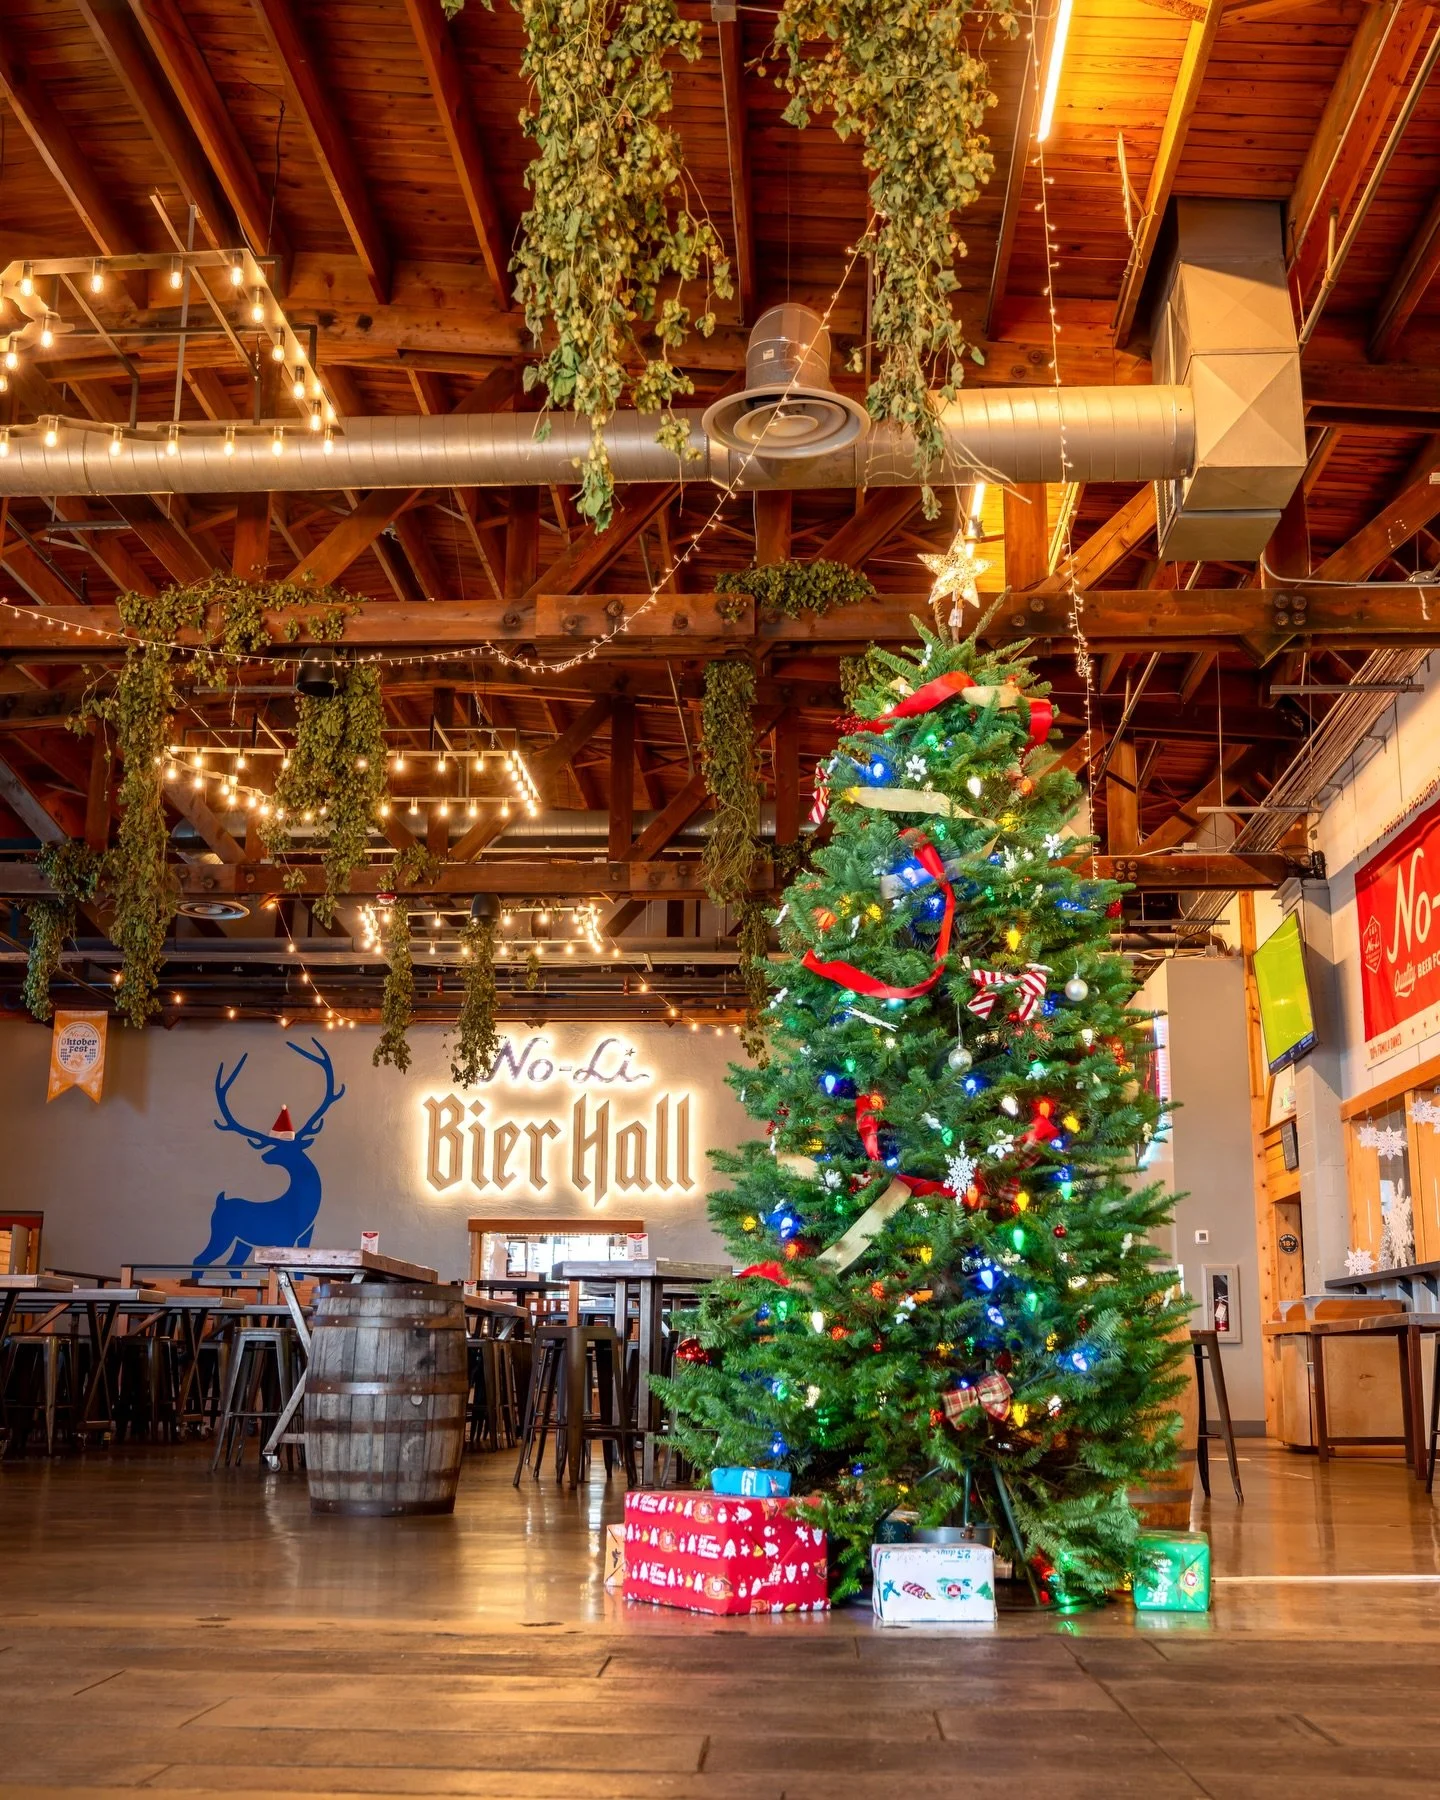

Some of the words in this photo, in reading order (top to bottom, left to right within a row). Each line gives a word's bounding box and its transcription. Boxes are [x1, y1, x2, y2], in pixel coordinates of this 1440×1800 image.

[69, 1045, 88, 1053] Fest
[476, 1036, 650, 1083] No-Li
[423, 1093, 561, 1192] Bier
[571, 1093, 696, 1208] Hall
[957, 1549, 971, 1559] 25
